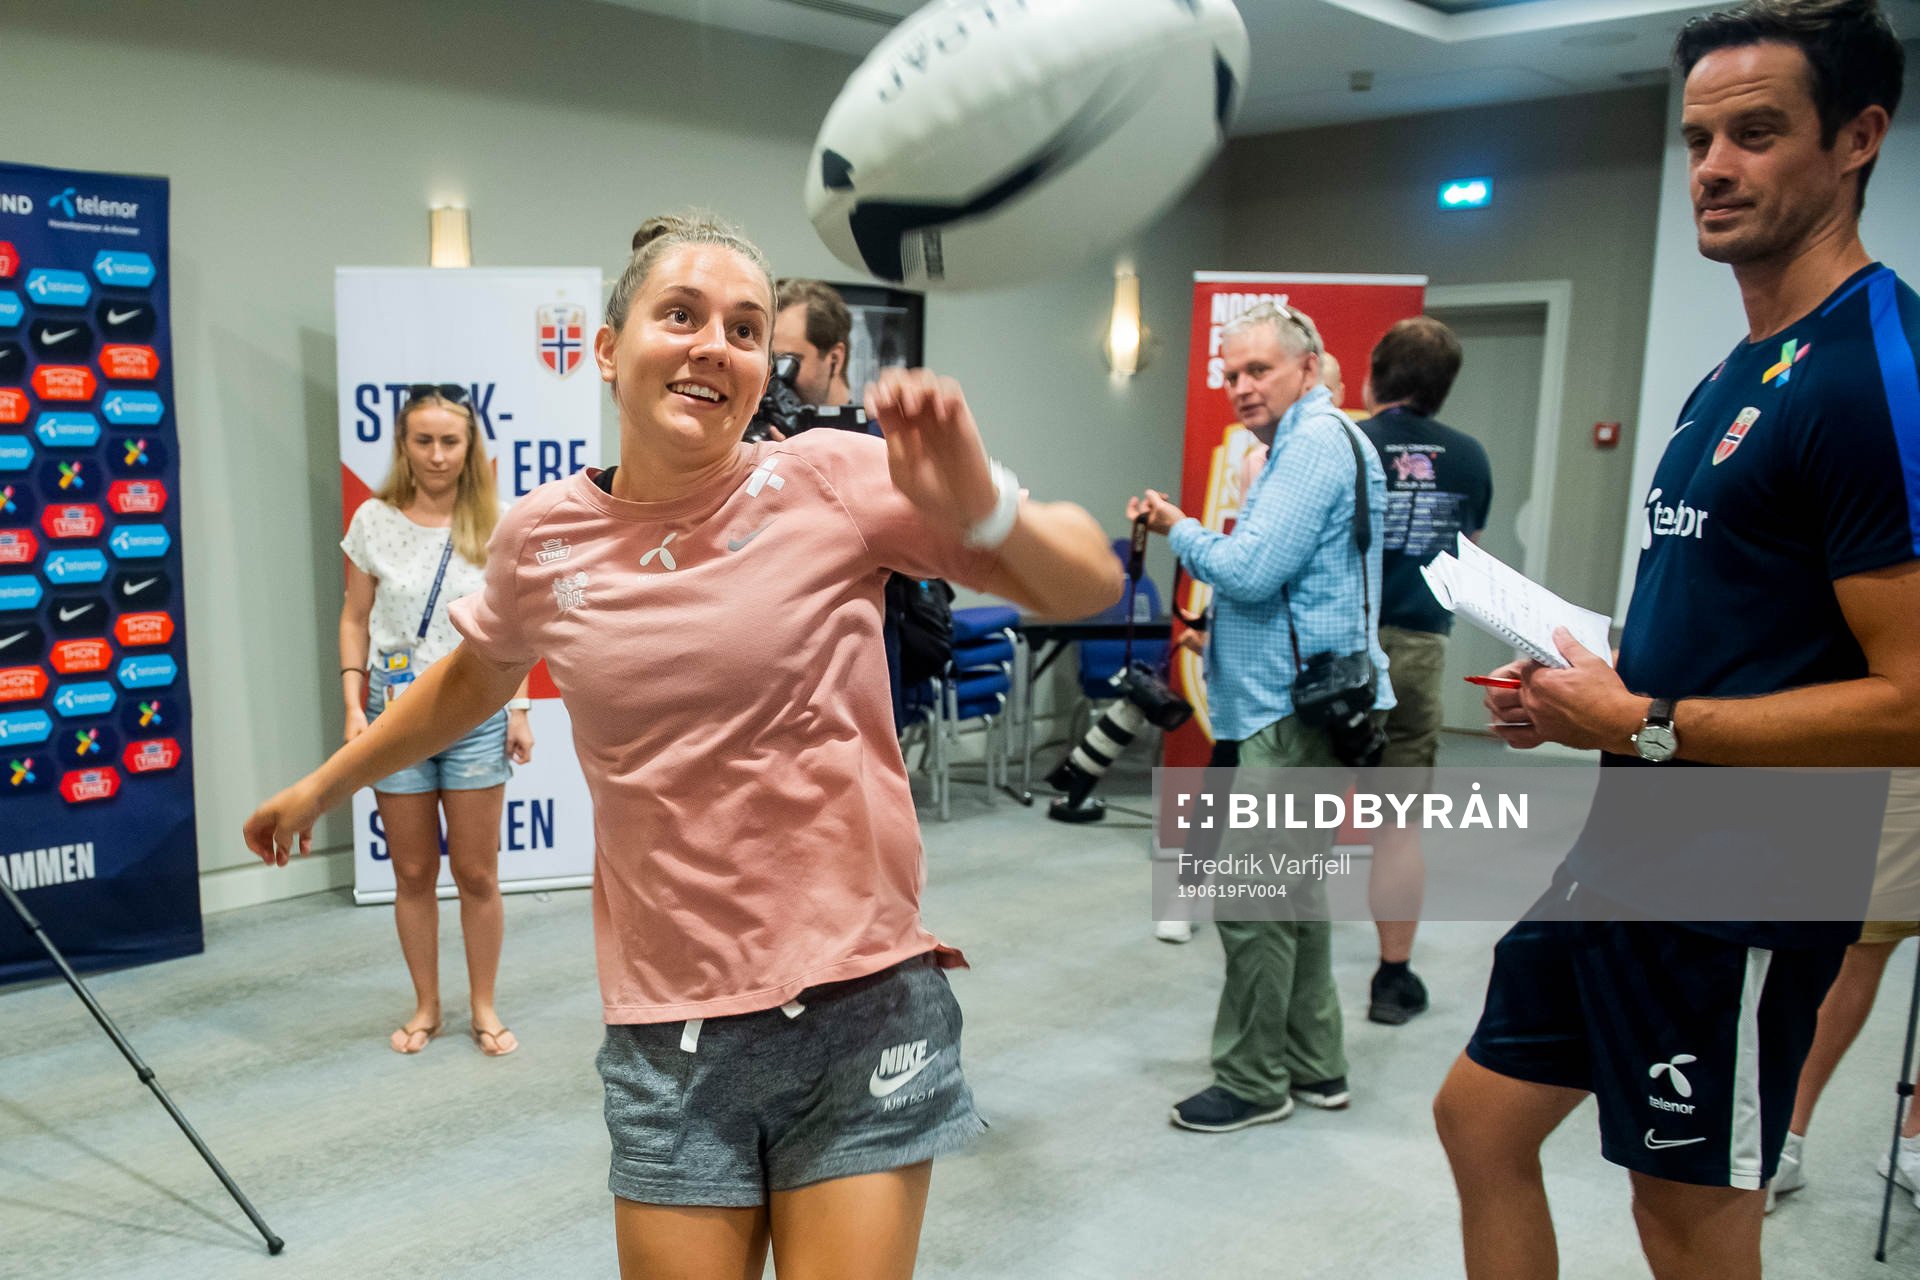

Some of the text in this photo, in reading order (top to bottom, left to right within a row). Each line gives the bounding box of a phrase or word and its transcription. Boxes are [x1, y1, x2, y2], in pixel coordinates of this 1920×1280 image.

[76, 194, 139, 219] telenor
[539, 550, 566, 562] TINE
[879, 1039, 928, 1076] NIKE
[883, 1095, 909, 1113] JUST
[1648, 1095, 1696, 1116] telenor
